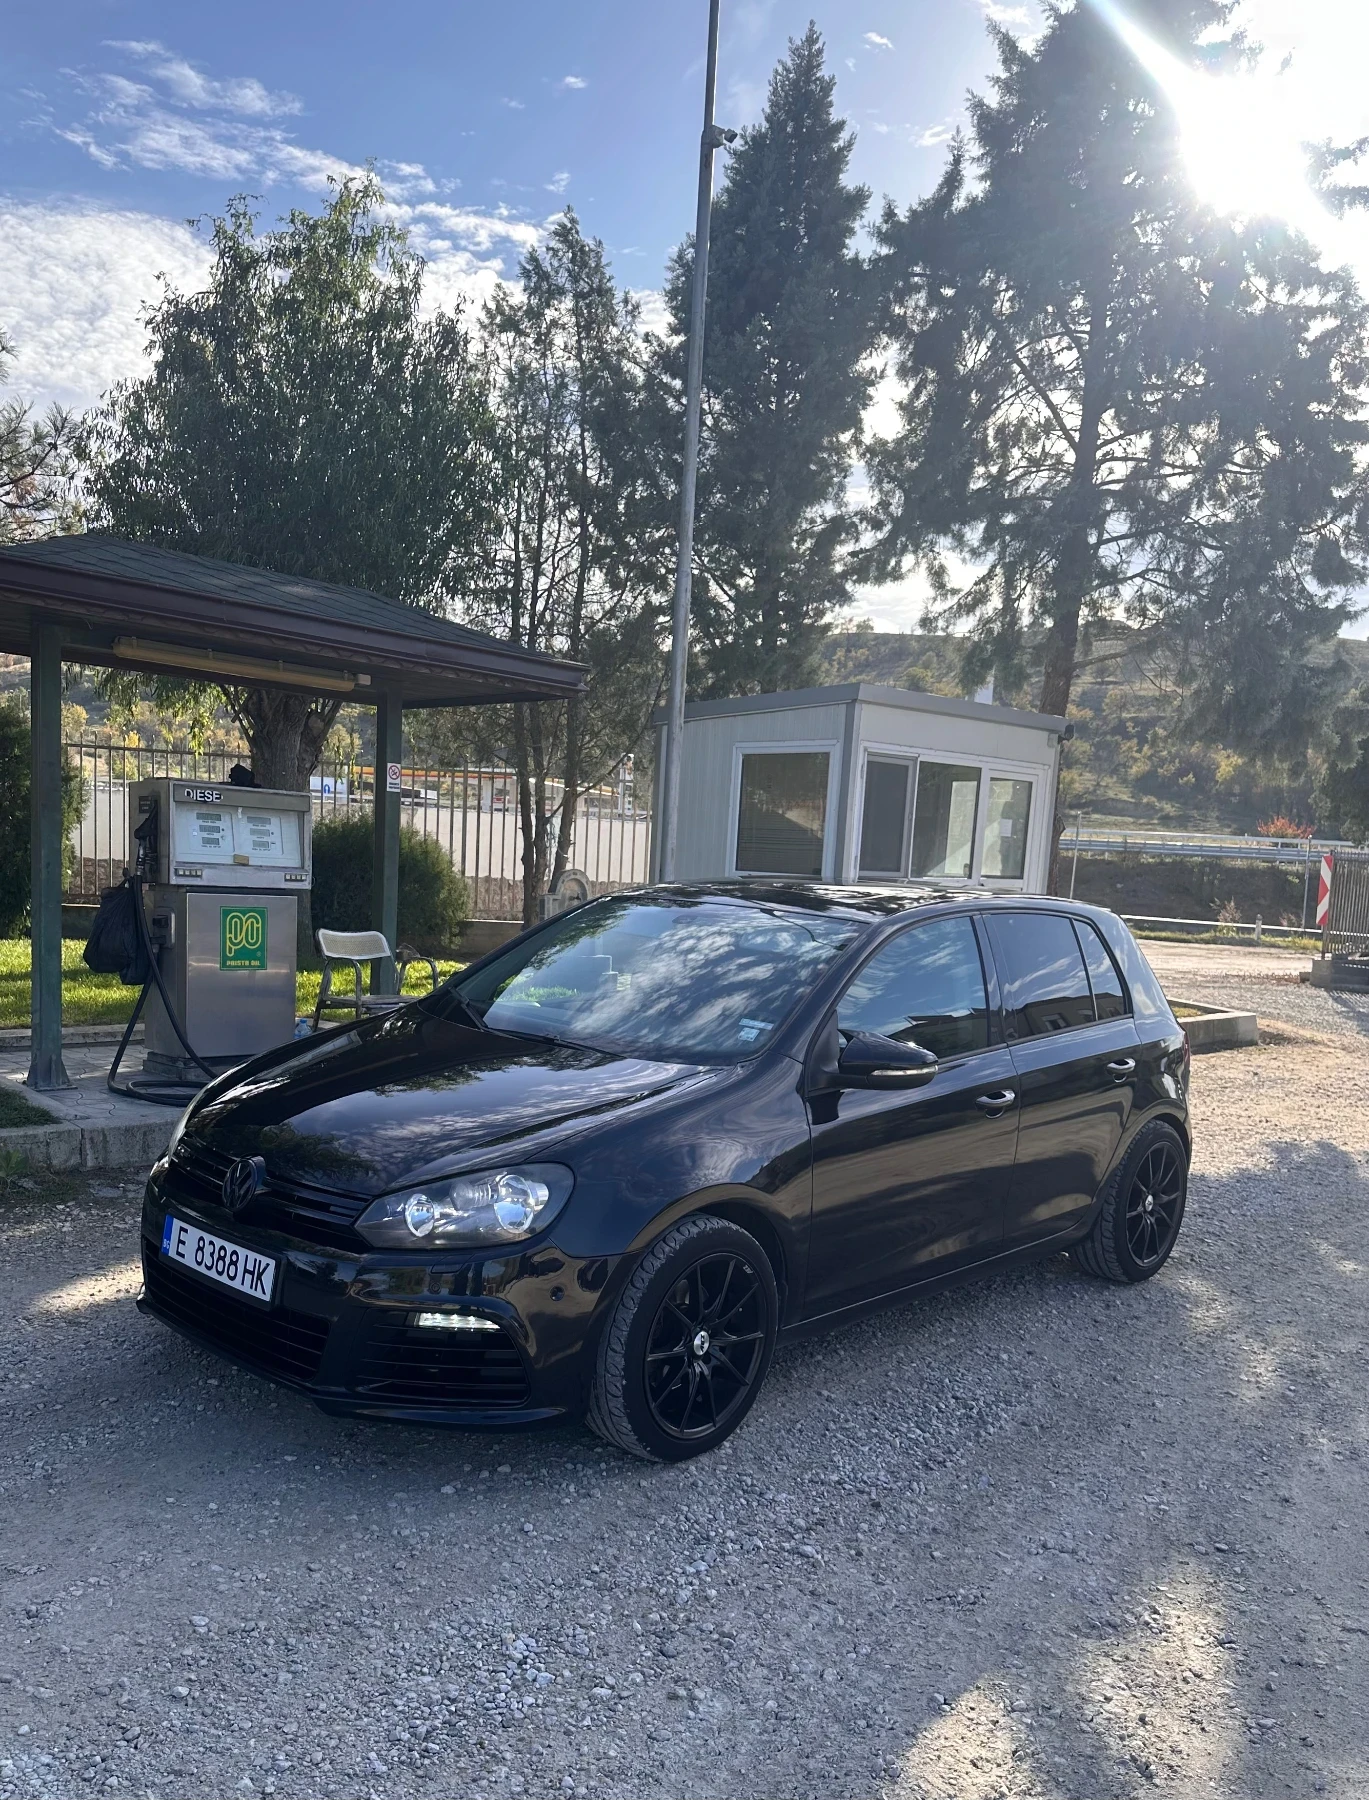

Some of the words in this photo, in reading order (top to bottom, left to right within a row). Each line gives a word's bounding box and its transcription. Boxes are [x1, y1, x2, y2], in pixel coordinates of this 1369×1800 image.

[184, 788, 224, 802] DIESE
[175, 1225, 189, 1259] E
[194, 1235, 240, 1282] 8388
[240, 1254, 271, 1296] HK
